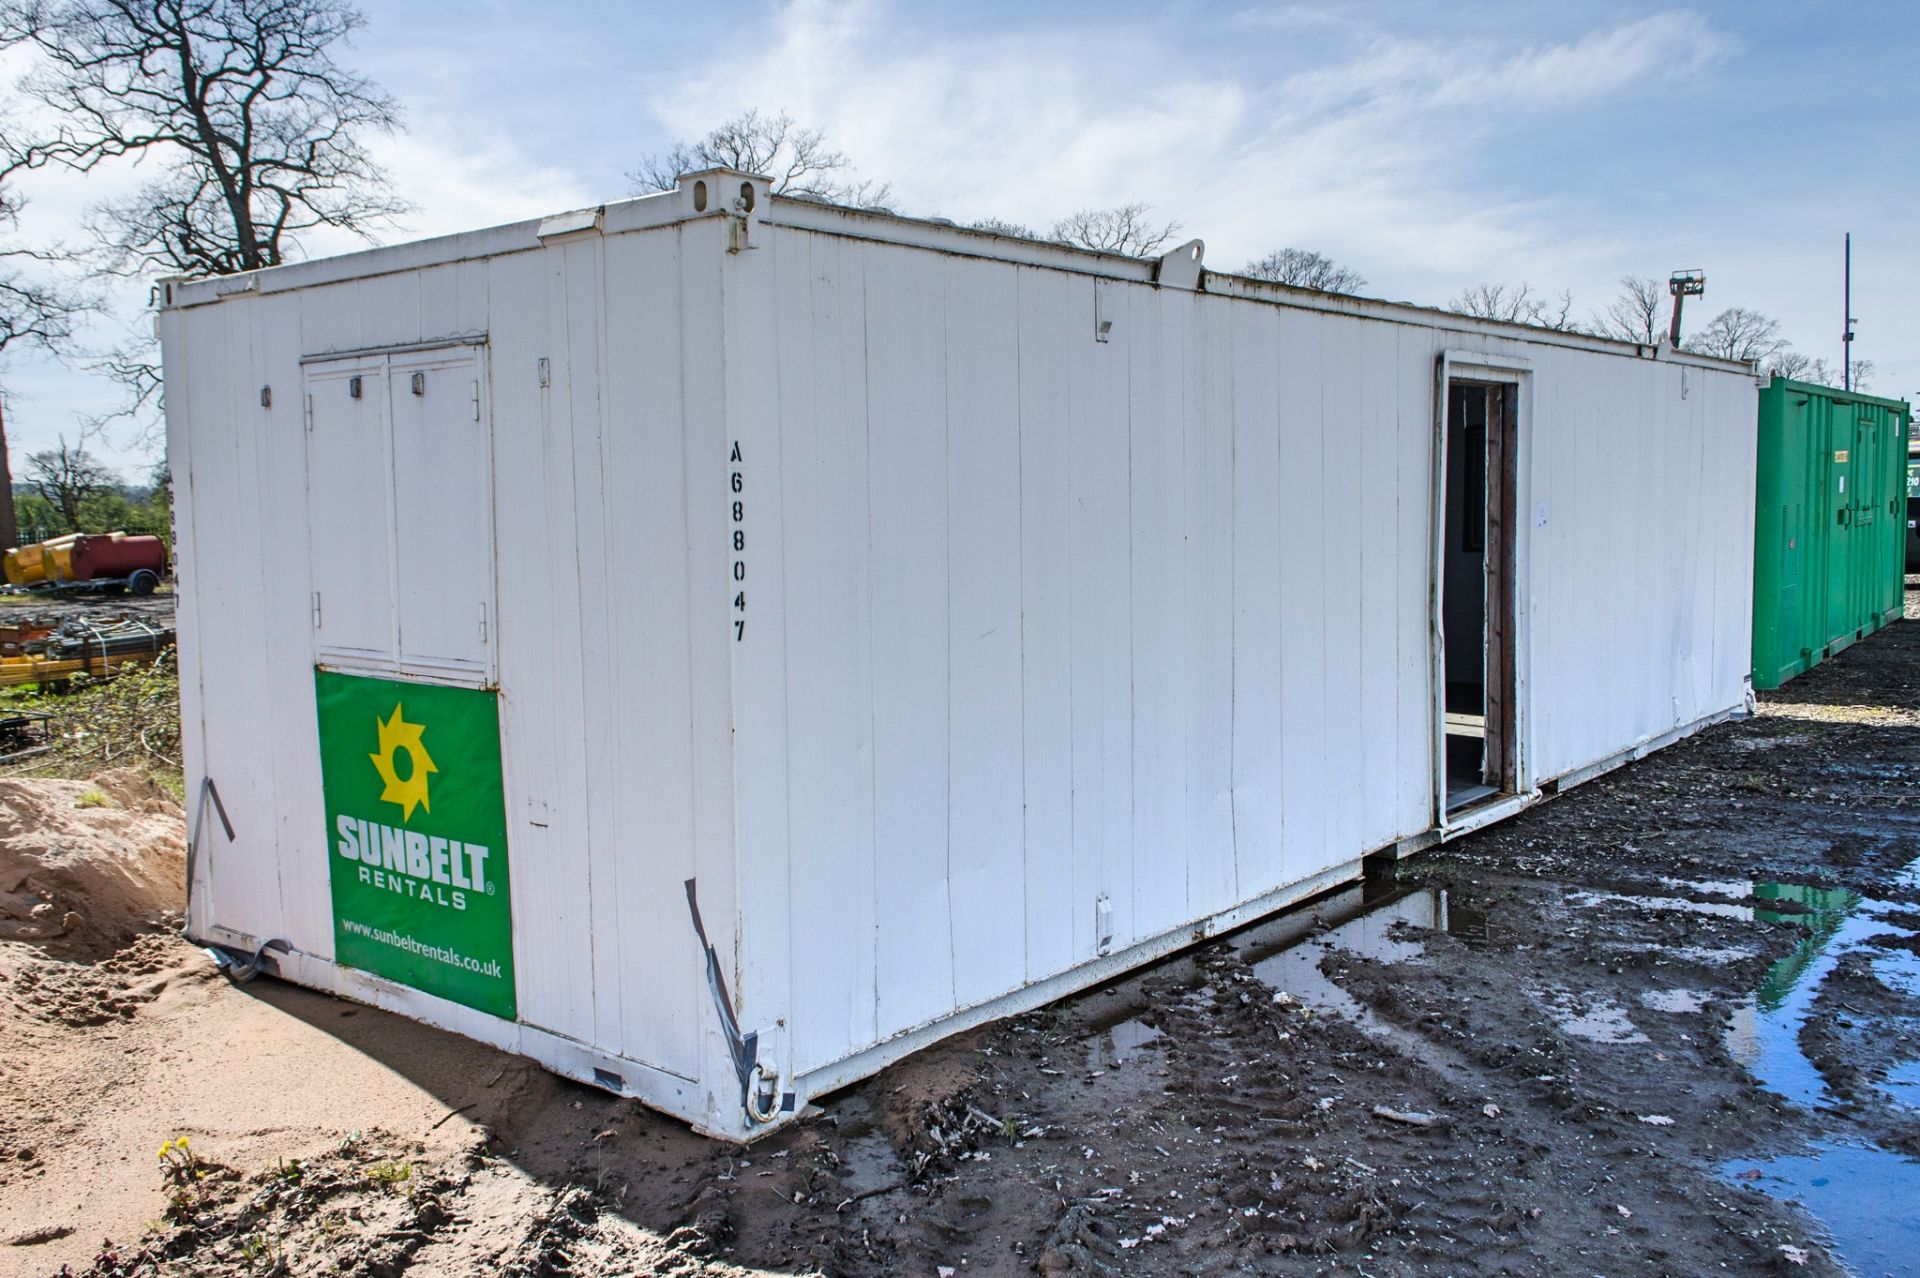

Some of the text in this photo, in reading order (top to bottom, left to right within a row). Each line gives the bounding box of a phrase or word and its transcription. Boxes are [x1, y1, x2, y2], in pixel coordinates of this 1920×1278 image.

[730, 441, 745, 641] A688047
[336, 814, 489, 893] SUNBELT
[358, 865, 466, 911] RENTALS
[342, 918, 502, 978] www.sunbeltrentals.co.uk
